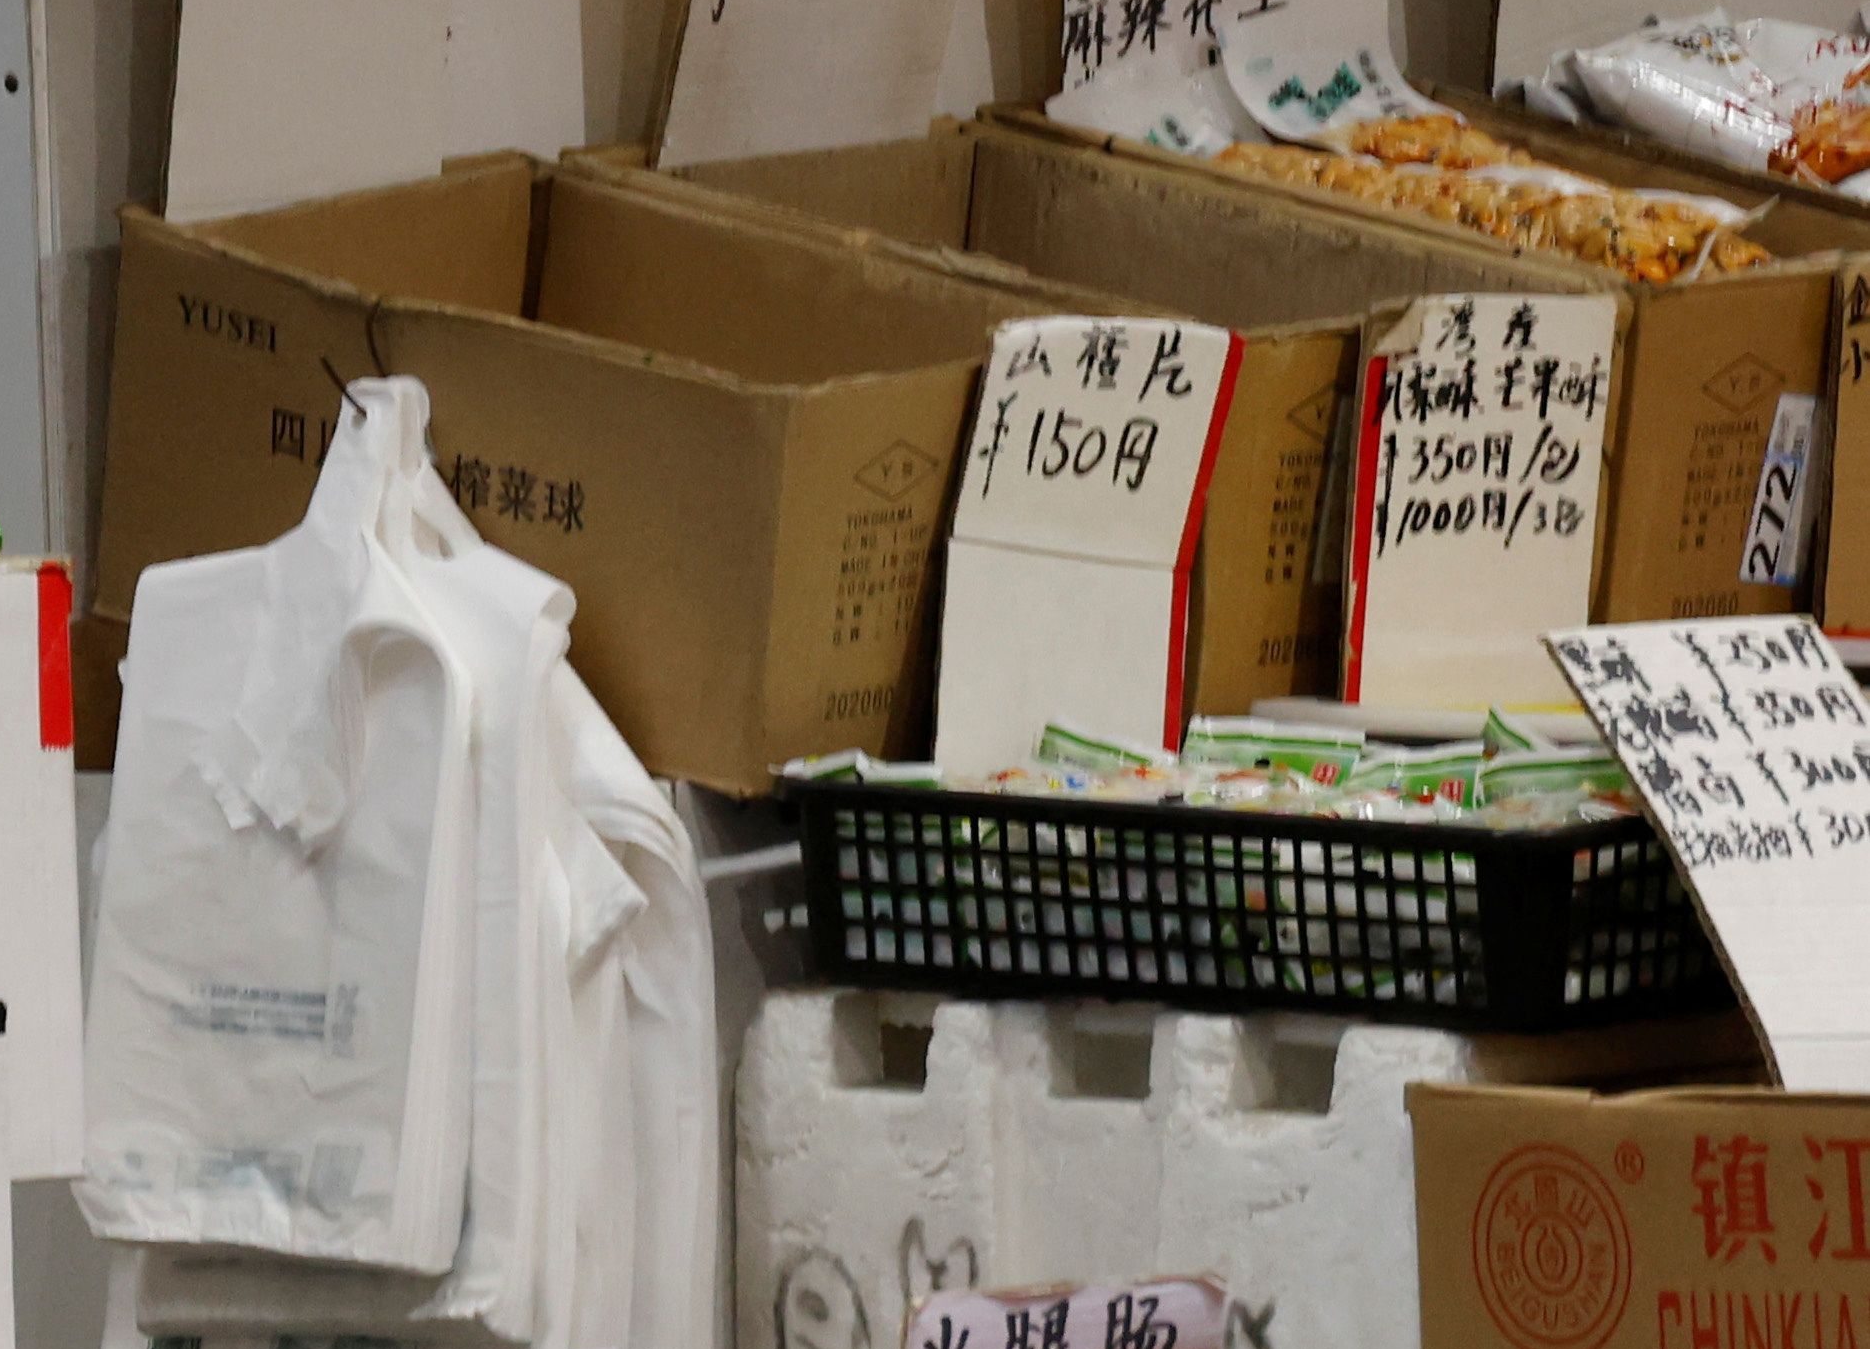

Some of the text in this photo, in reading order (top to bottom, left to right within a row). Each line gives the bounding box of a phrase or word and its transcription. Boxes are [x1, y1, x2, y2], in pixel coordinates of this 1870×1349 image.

[177, 294, 280, 353] YUSEI
[979, 391, 1161, 498] ¥150円
[1744, 460, 1797, 581] 272
